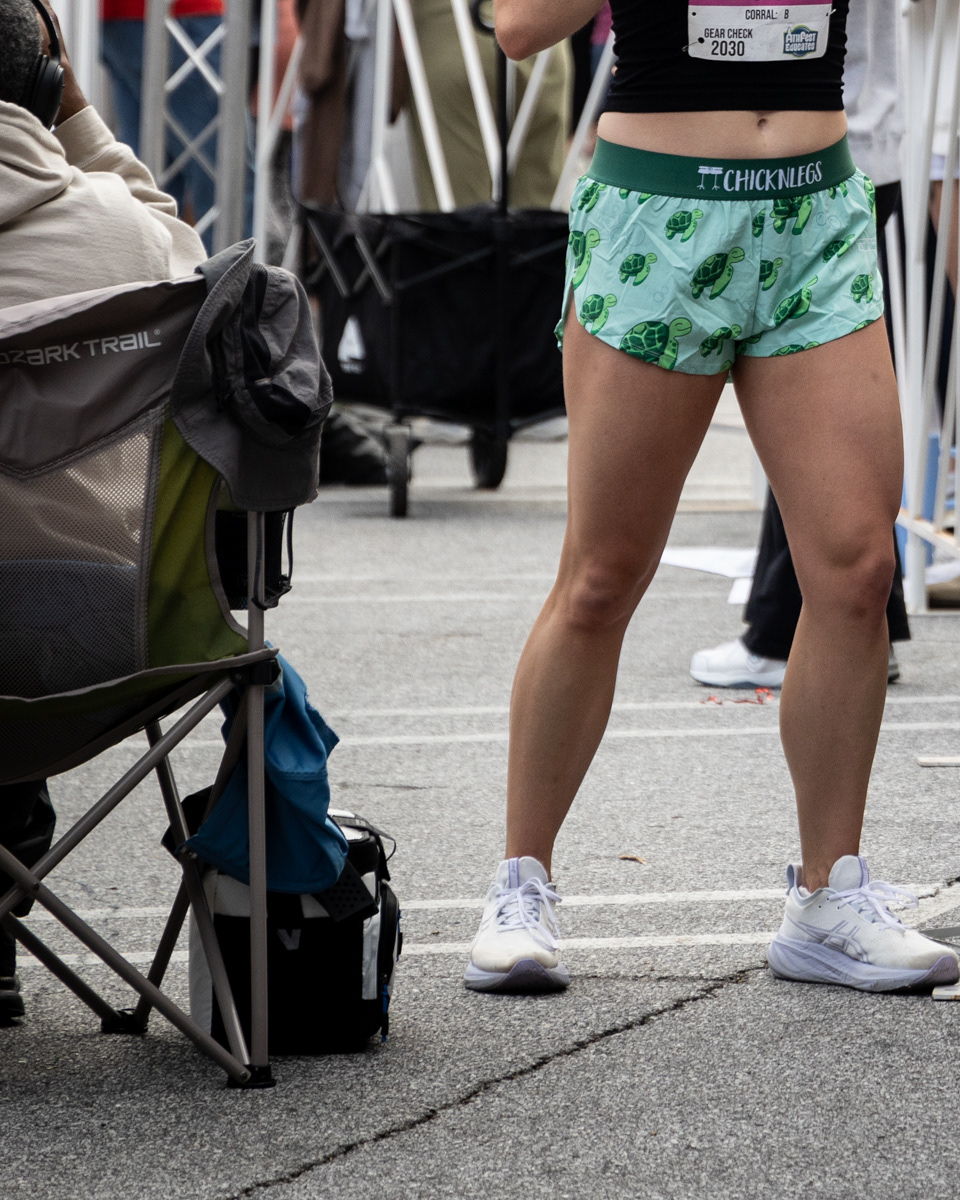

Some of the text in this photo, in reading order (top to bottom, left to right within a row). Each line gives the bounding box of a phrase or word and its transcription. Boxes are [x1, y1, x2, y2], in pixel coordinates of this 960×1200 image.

[745, 9, 790, 20] CORRAL: B
[704, 28, 754, 39] GEAR CHECK
[711, 40, 745, 56] 2030
[723, 161, 823, 192] CHICKNLEGS
